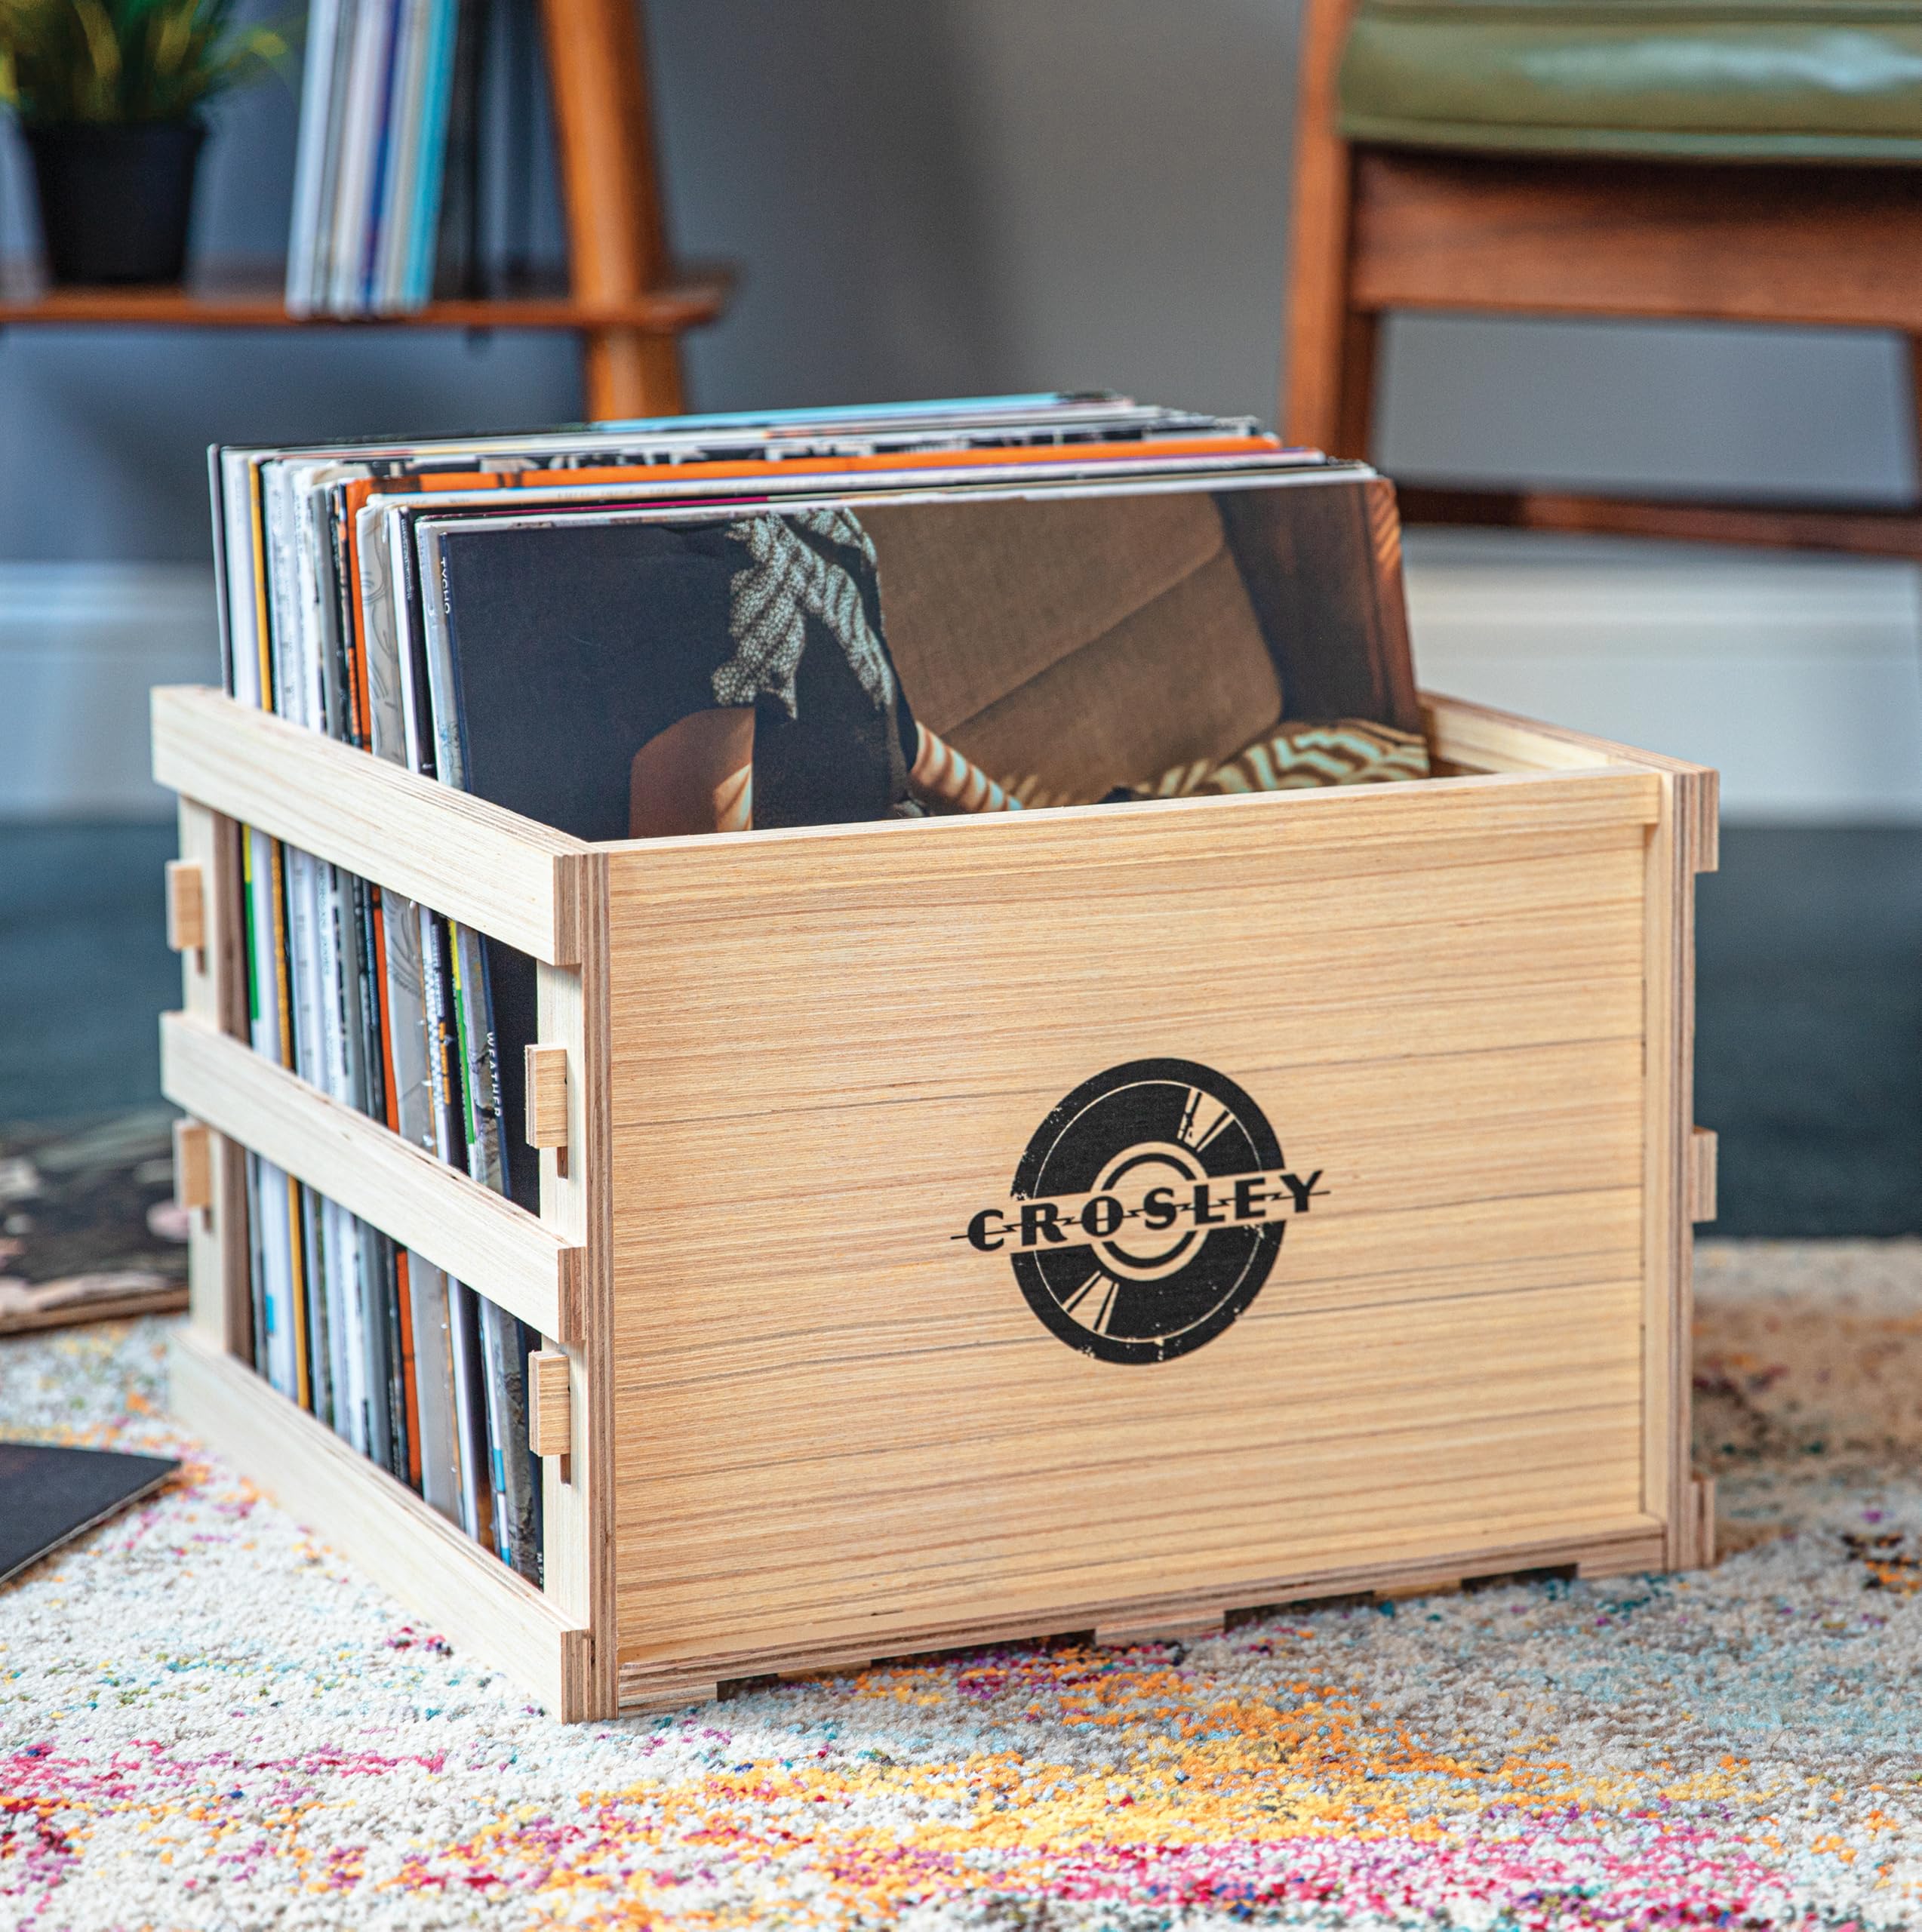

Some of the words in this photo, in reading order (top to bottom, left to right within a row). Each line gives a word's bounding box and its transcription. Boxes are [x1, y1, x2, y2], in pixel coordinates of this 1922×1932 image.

[441, 557, 451, 614] TYCHO
[487, 1032, 503, 1118] WEATHER
[967, 1170, 1323, 1252] CROSLEY
